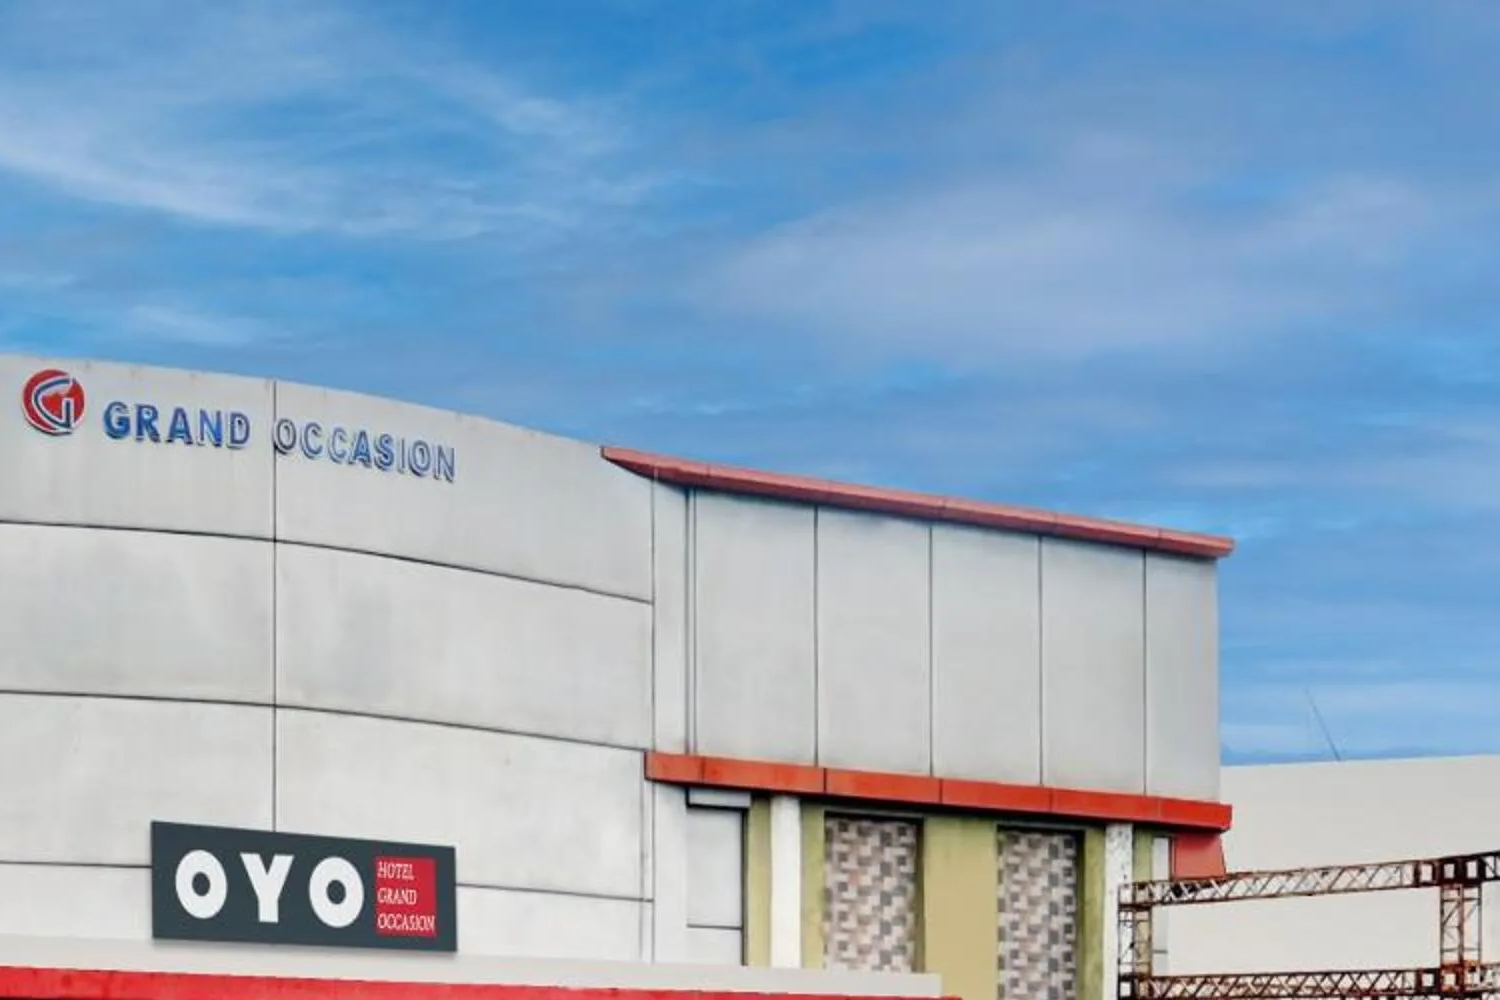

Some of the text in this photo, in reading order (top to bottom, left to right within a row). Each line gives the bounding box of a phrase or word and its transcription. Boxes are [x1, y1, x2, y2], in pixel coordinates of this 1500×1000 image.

[103, 400, 456, 482] GRAND OCCASION
[377, 861, 415, 880] HOTEL
[175, 849, 364, 928] OYO
[377, 887, 418, 905] GRAND
[377, 912, 436, 932] OCCASION
